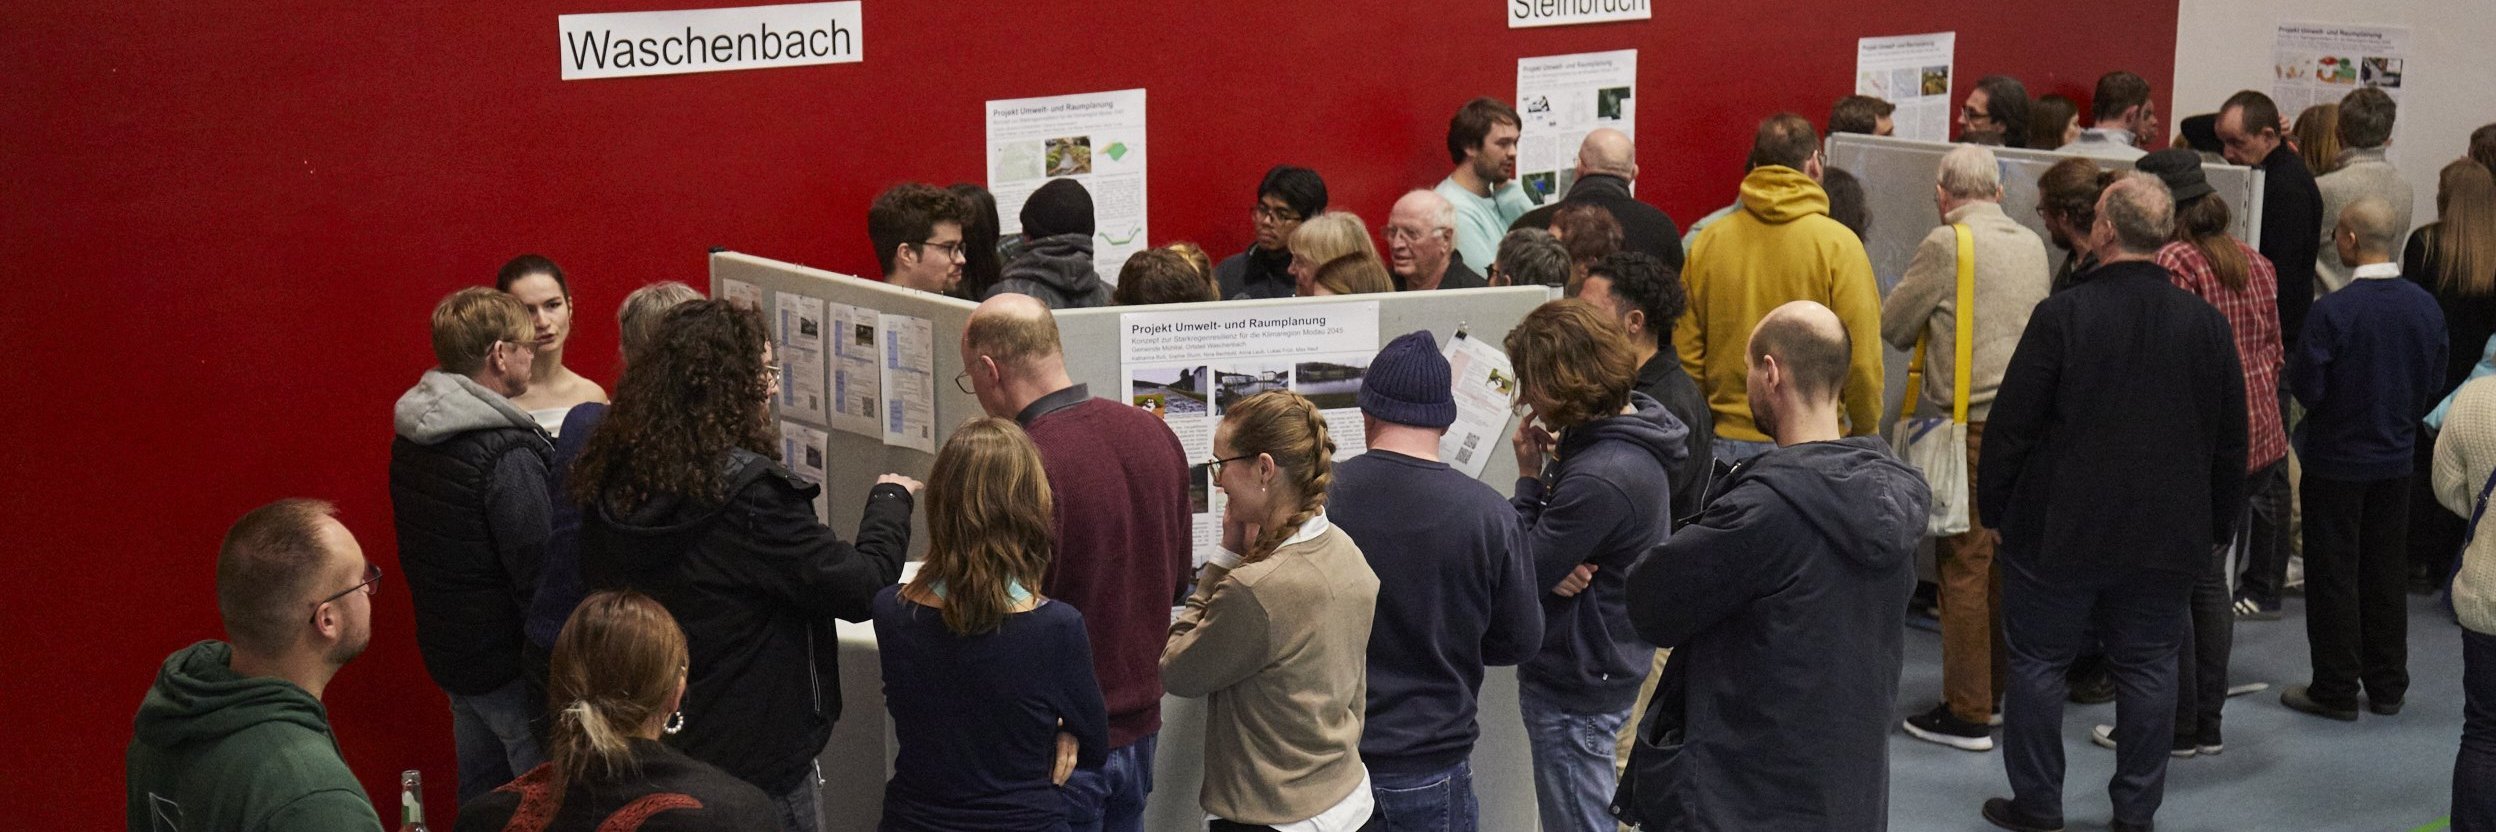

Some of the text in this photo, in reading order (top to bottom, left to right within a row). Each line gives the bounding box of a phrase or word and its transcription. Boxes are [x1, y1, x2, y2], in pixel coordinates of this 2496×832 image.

[567, 18, 851, 70] Waschenbach
[993, 108, 1019, 119] Projekt
[1050, 103, 1064, 113] und
[1066, 101, 1114, 112] Raumplanung
[1132, 316, 1327, 336] Projekt Umwelt- und Raumplanung
